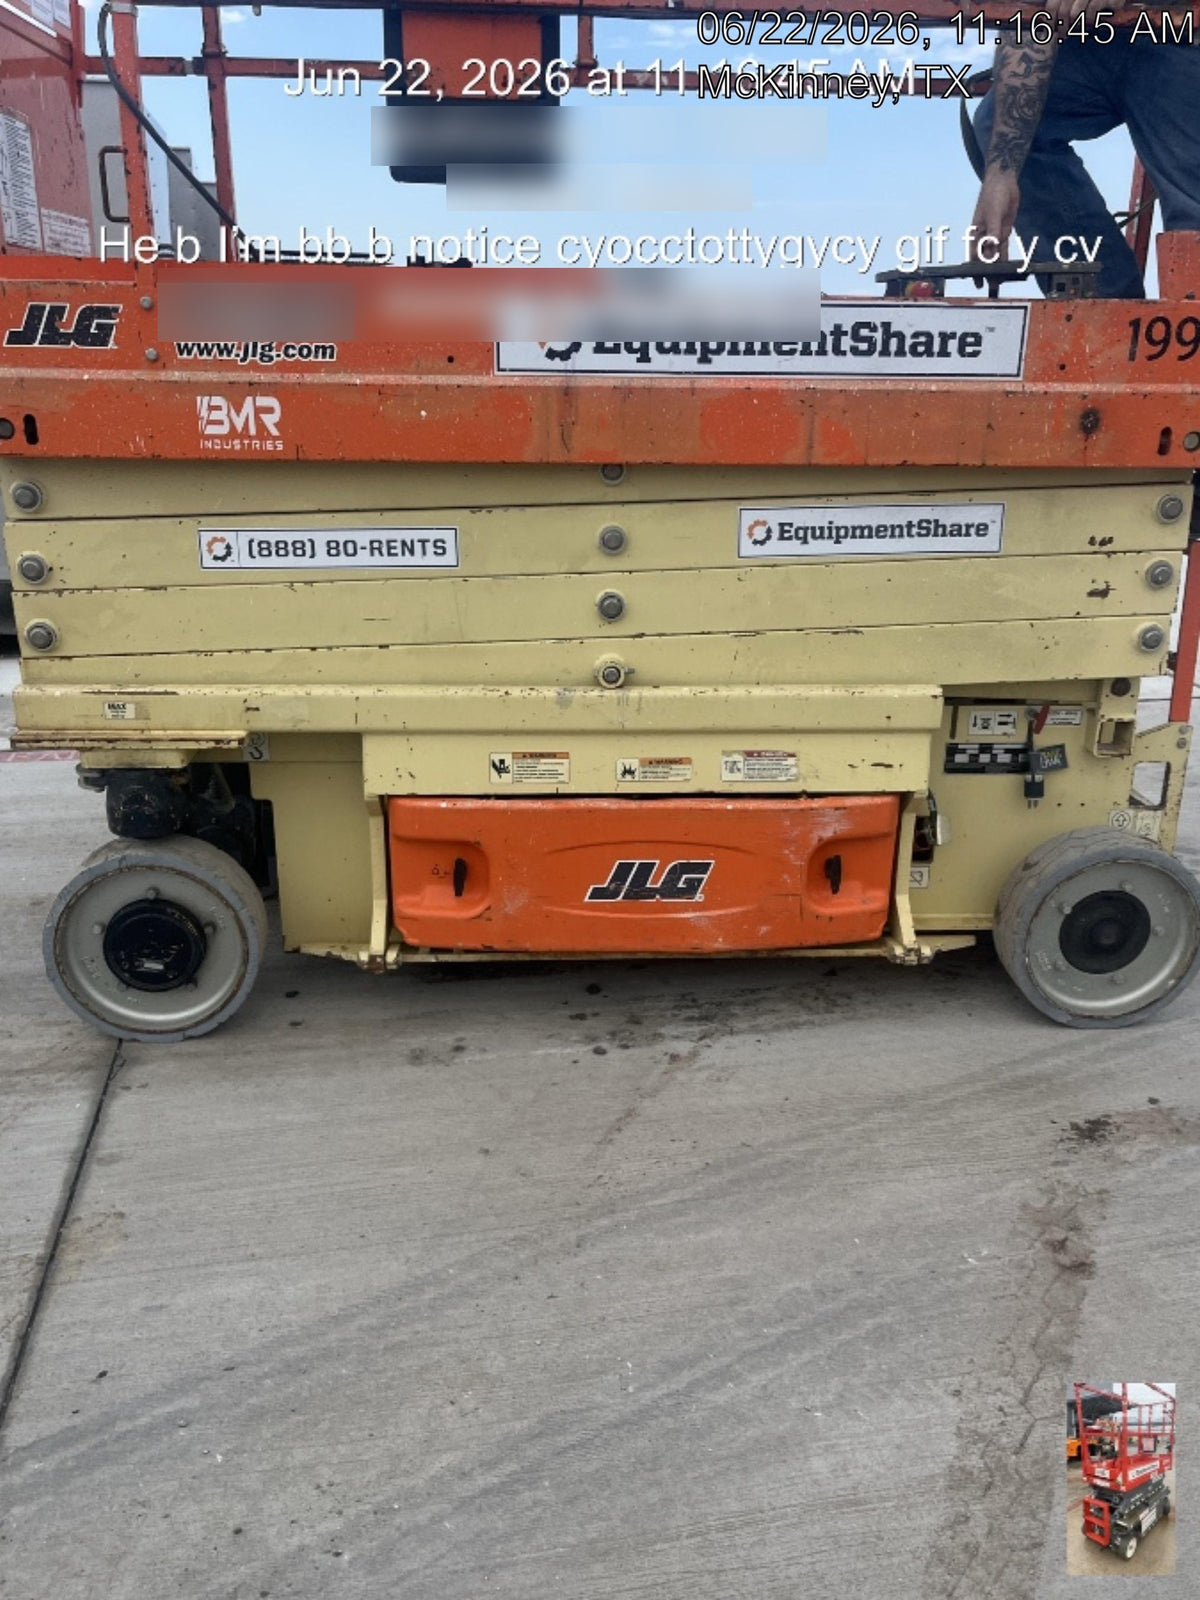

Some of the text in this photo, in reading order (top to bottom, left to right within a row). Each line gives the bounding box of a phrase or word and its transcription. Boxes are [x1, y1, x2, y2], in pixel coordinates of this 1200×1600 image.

[3, 301, 124, 349] JLG
[1127, 315, 1200, 362] 199
[175, 341, 338, 365] www.jlg.com
[196, 395, 282, 437] BMR
[199, 438, 284, 452] INDUSTRIES
[247, 537, 448, 560] (888) 80-RENTS
[777, 518, 990, 545] EquipmentShare
[584, 859, 716, 902] JLG
